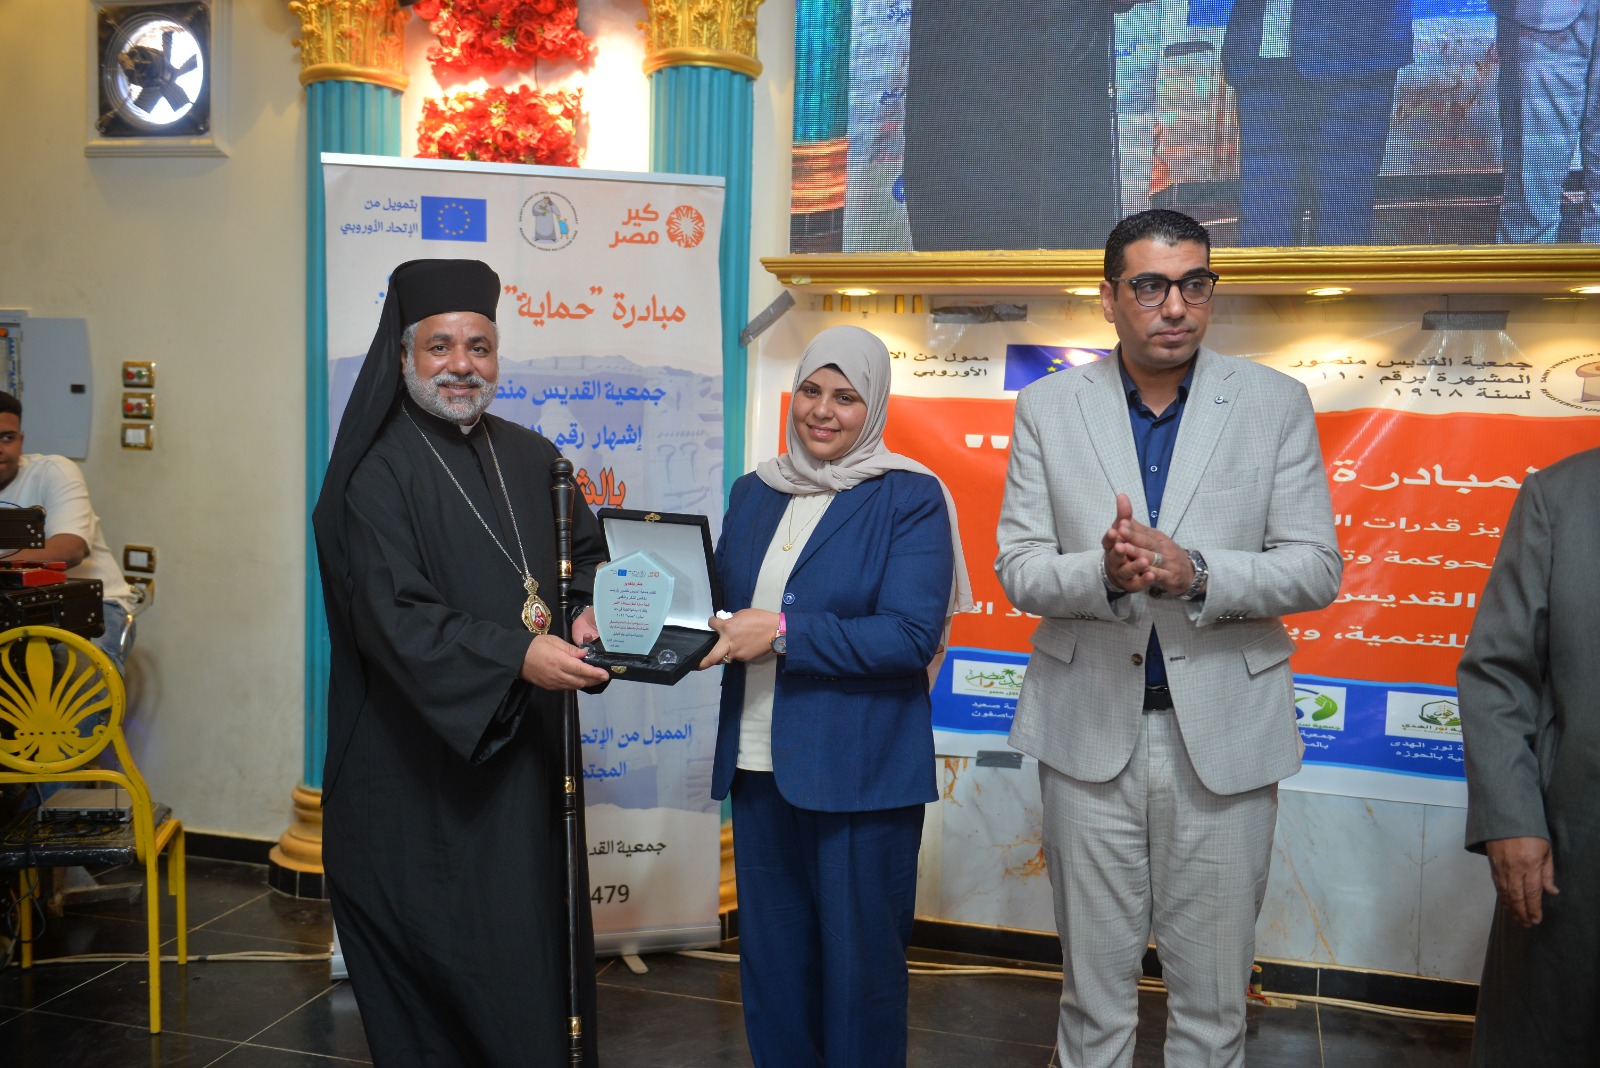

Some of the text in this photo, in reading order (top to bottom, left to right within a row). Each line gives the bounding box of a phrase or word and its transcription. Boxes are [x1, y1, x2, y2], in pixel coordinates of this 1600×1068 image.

[364, 197, 418, 212] بتمويل من
[621, 202, 660, 228] كير
[340, 219, 419, 238] الإتحاد الأوروبي
[608, 230, 660, 249] مصر
[611, 293, 687, 330] مبادرة
[913, 353, 939, 362] من
[943, 352, 990, 363] ممول
[1376, 356, 1453, 369] القديس
[1461, 355, 1534, 371] جمعية
[913, 366, 988, 378] الأوروبي
[1436, 372, 1532, 385] المشهرة
[531, 379, 601, 407] القديس
[604, 381, 668, 407] جمعية
[1393, 387, 1532, 400] لسنة ١٩٦٨
[554, 422, 586, 453] رقم
[591, 423, 643, 452] إشهار
[1333, 459, 1539, 494] مبادرة
[575, 466, 627, 510] بالش
[1334, 513, 1501, 538] يز قدرات ال
[1384, 550, 1496, 570] حوكمة
[580, 723, 693, 750] الممول من الإتح
[1303, 741, 1329, 750] بالم
[588, 840, 668, 858] جمعية القد
[590, 883, 631, 905] 479
